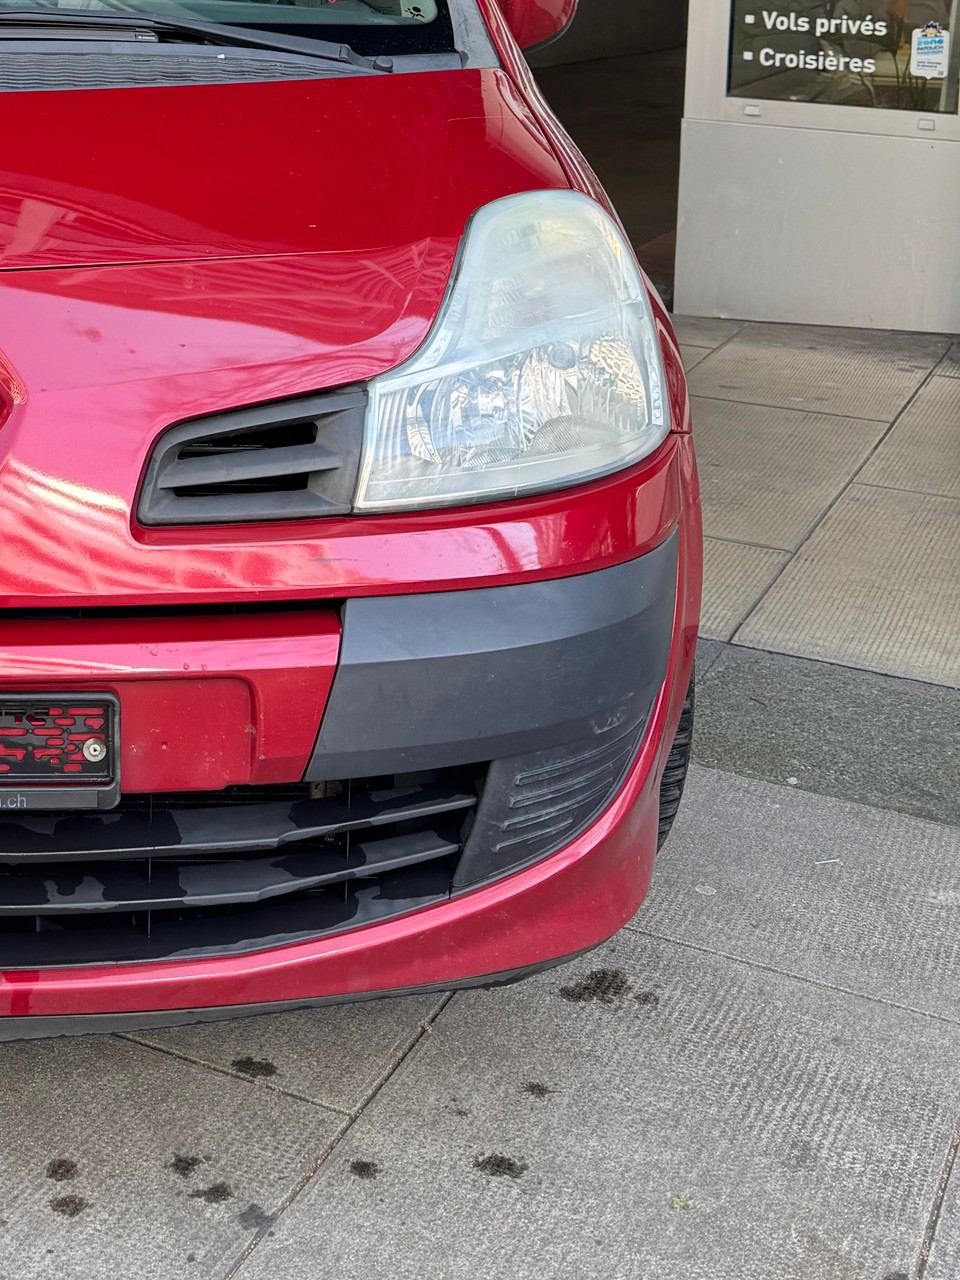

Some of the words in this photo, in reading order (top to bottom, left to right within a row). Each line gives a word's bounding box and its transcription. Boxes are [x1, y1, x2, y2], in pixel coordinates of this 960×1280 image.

[761, 11, 810, 31] Vols
[815, 15, 888, 37] privés
[758, 48, 876, 74] Croisières
